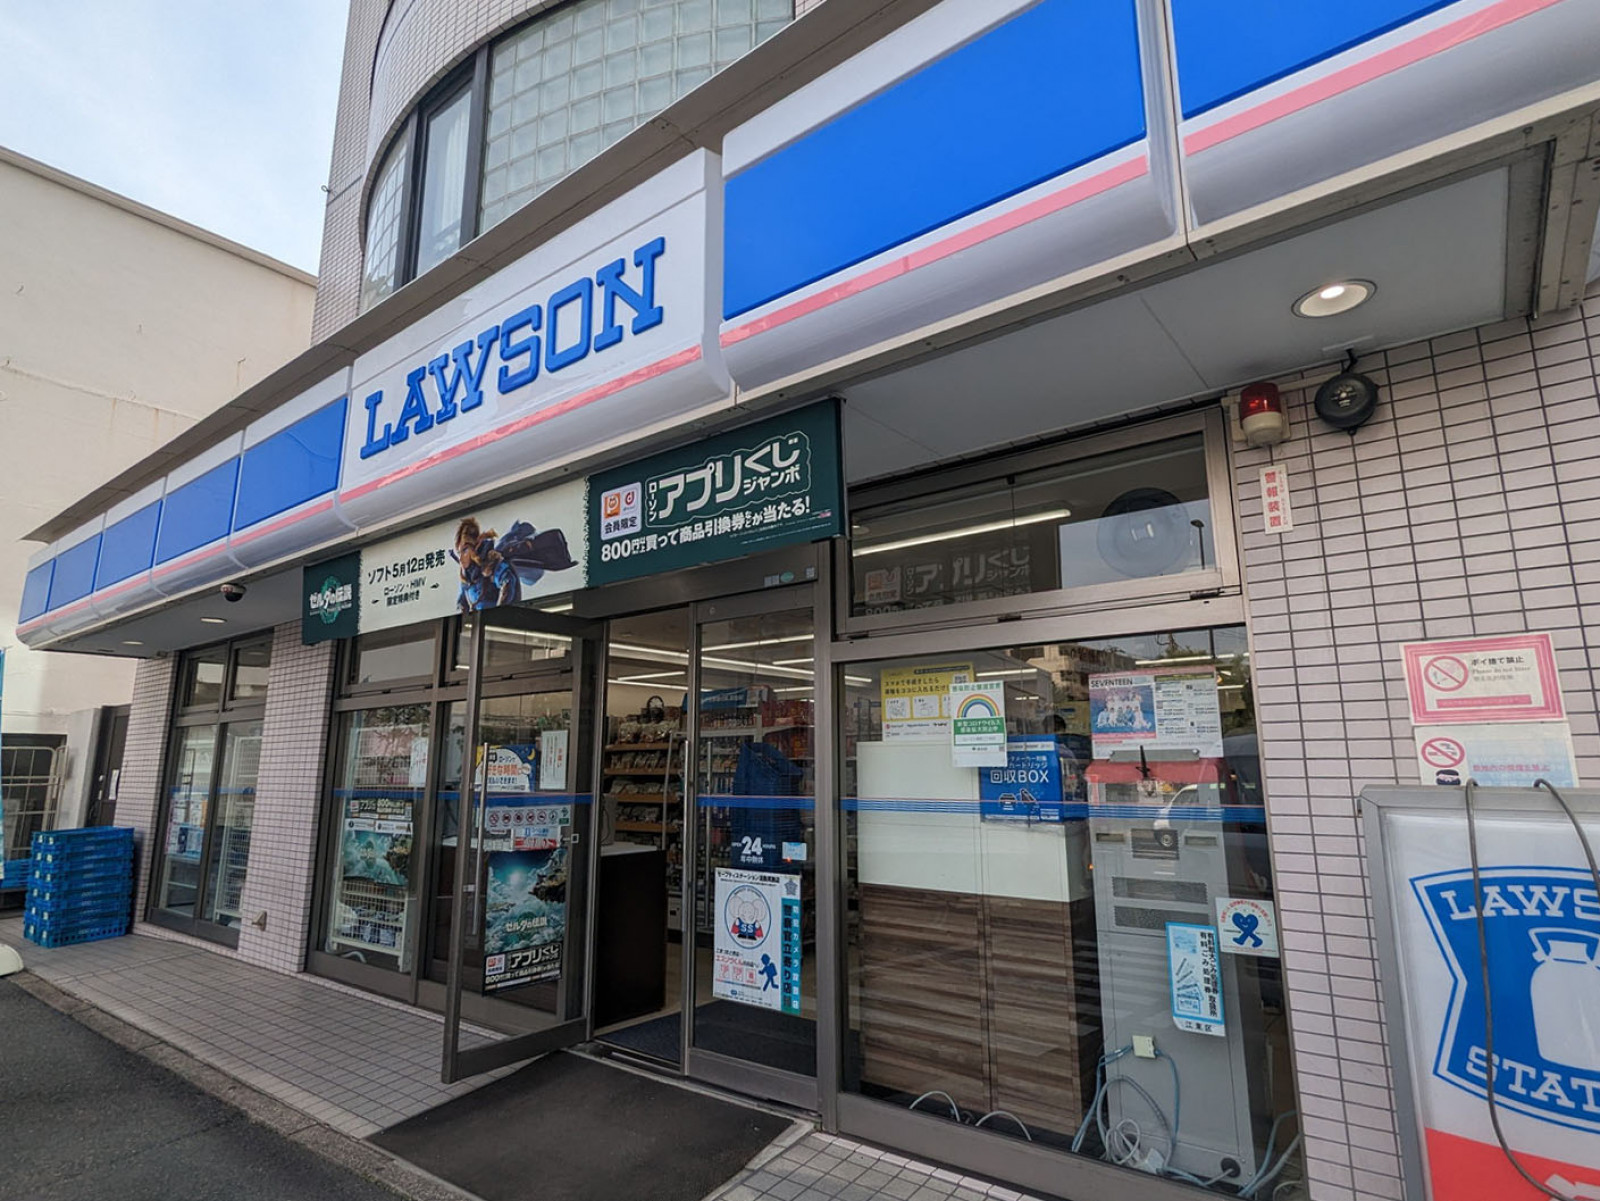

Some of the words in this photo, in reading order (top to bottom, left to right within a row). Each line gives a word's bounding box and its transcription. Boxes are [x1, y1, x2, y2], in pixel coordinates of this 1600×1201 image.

[360, 236, 666, 460] LAWSON
[659, 437, 800, 519] アプリくじ
[743, 466, 800, 495] ジャンボ
[649, 481, 657, 522] ローソン
[604, 516, 637, 534] 会員限定
[368, 549, 446, 585] ソフト5月12日発売
[309, 583, 352, 610] ゼルダの伝説
[1471, 656, 1524, 666] ポイ捨て禁止
[1090, 677, 1133, 688] SEVENTEEN
[990, 769, 1049, 784] 回収BOX
[741, 835, 763, 856] 24
[1185, 1020, 1213, 1032] 江東区
